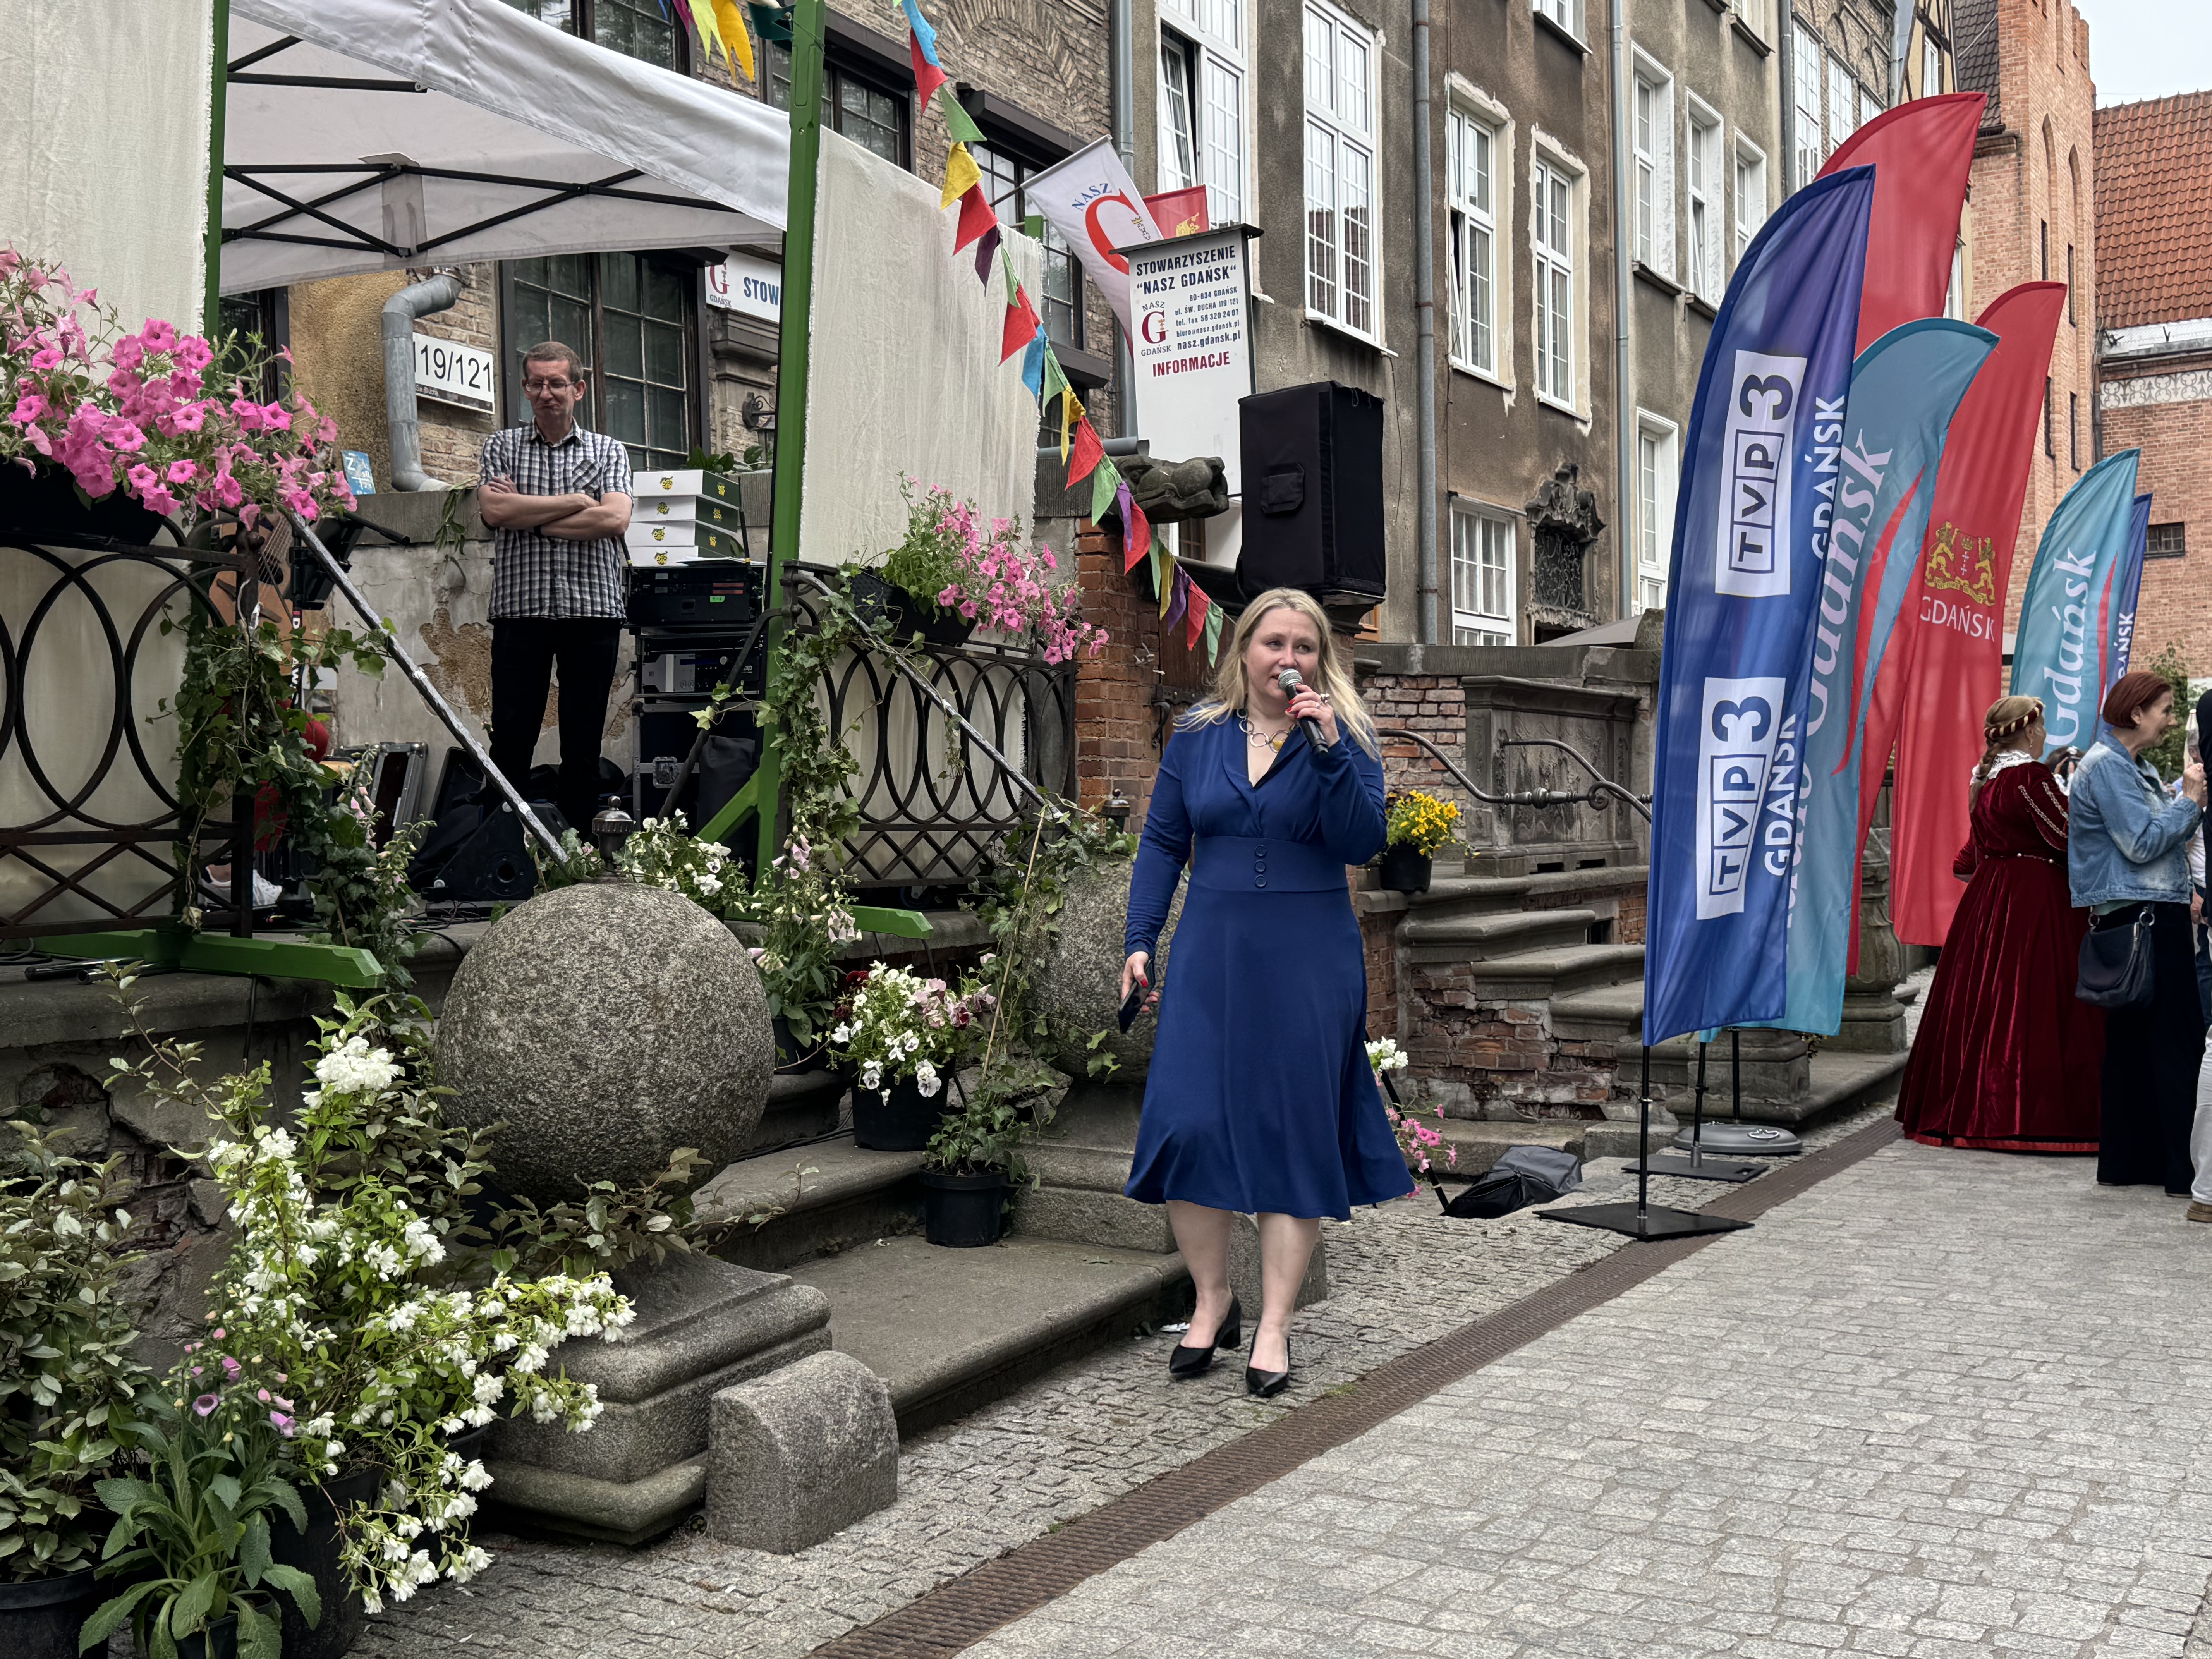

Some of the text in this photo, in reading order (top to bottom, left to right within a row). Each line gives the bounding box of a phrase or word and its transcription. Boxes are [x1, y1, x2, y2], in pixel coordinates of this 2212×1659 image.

[1072, 183, 1113, 211] NASZ
[1136, 245, 1235, 276] STOWARZYSZENIE
[709, 295, 732, 307] GDAŃSK
[1214, 286, 1237, 297] GDAŃSK
[1142, 301, 1165, 312] NASZ
[1184, 305, 1195, 314] ŚW.
[1197, 302, 1217, 312] DUCHA
[1219, 298, 1238, 307] 119/121
[1210, 312, 1221, 321] 320
[1223, 310, 1230, 318] 24
[1141, 310, 1169, 344] G
[1176, 319, 1240, 338] biuro@nasz.gdansk.pl
[1177, 330, 1240, 350] nasz.gdansk.pl
[1141, 345, 1171, 356] GDAŃSK
[1152, 351, 1230, 377] INFORMACJE
[1804, 395, 1845, 560] GDAŃSK
[2044, 547, 2097, 746] Gdańsk
